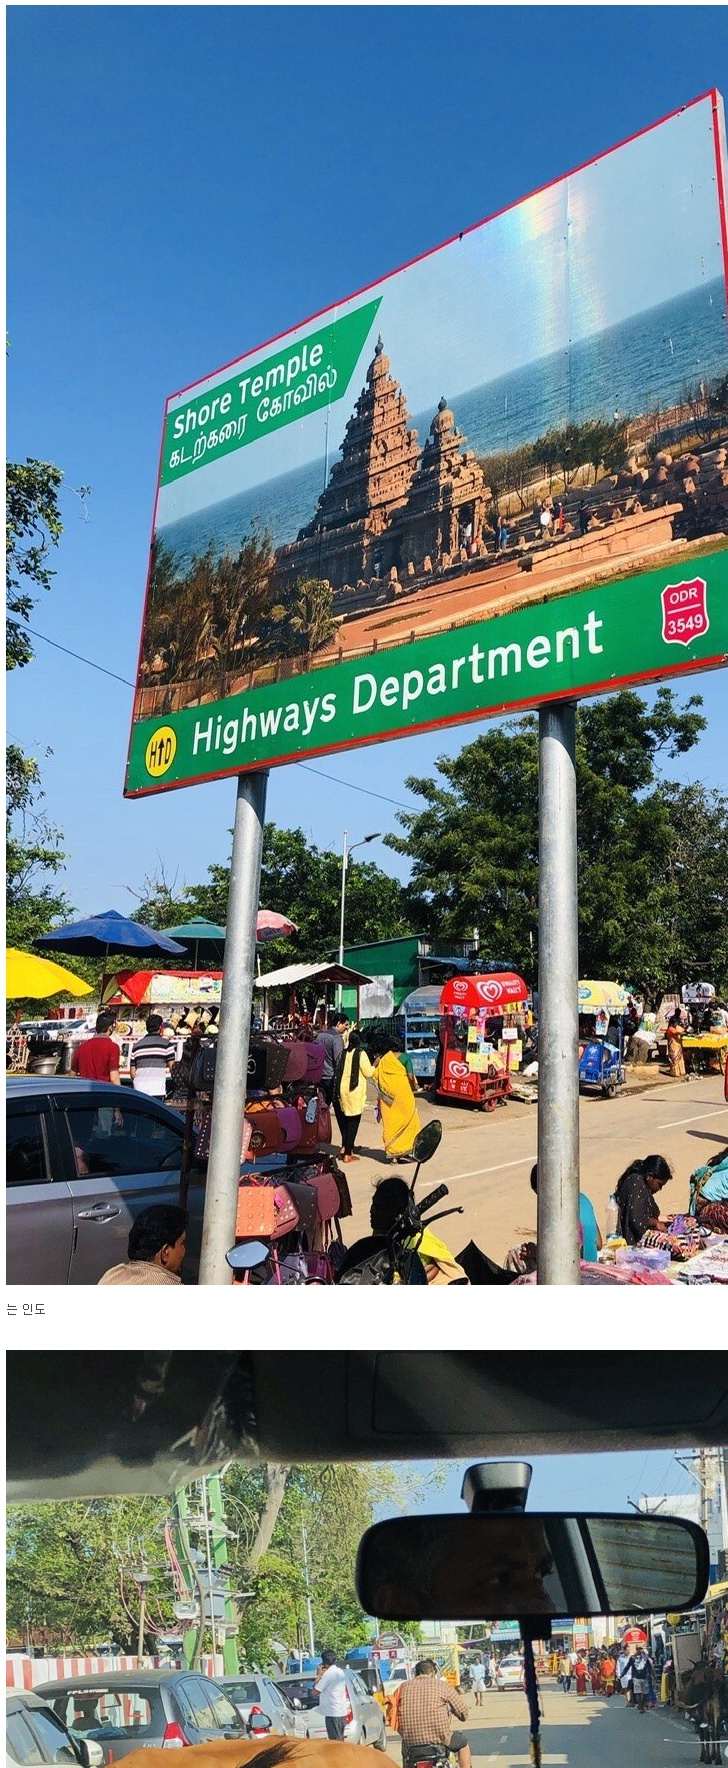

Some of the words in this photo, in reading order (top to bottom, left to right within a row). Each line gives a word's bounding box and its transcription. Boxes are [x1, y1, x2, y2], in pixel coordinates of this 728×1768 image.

[169, 413, 248, 468] கடற்கரை
[256, 365, 337, 423] கோவில்
[173, 392, 232, 439] Shore
[239, 344, 324, 405] Temple
[668, 614, 703, 635] 3549
[669, 588, 698, 604] ODR
[193, 692, 336, 755] Highways
[352, 611, 604, 715] Department
